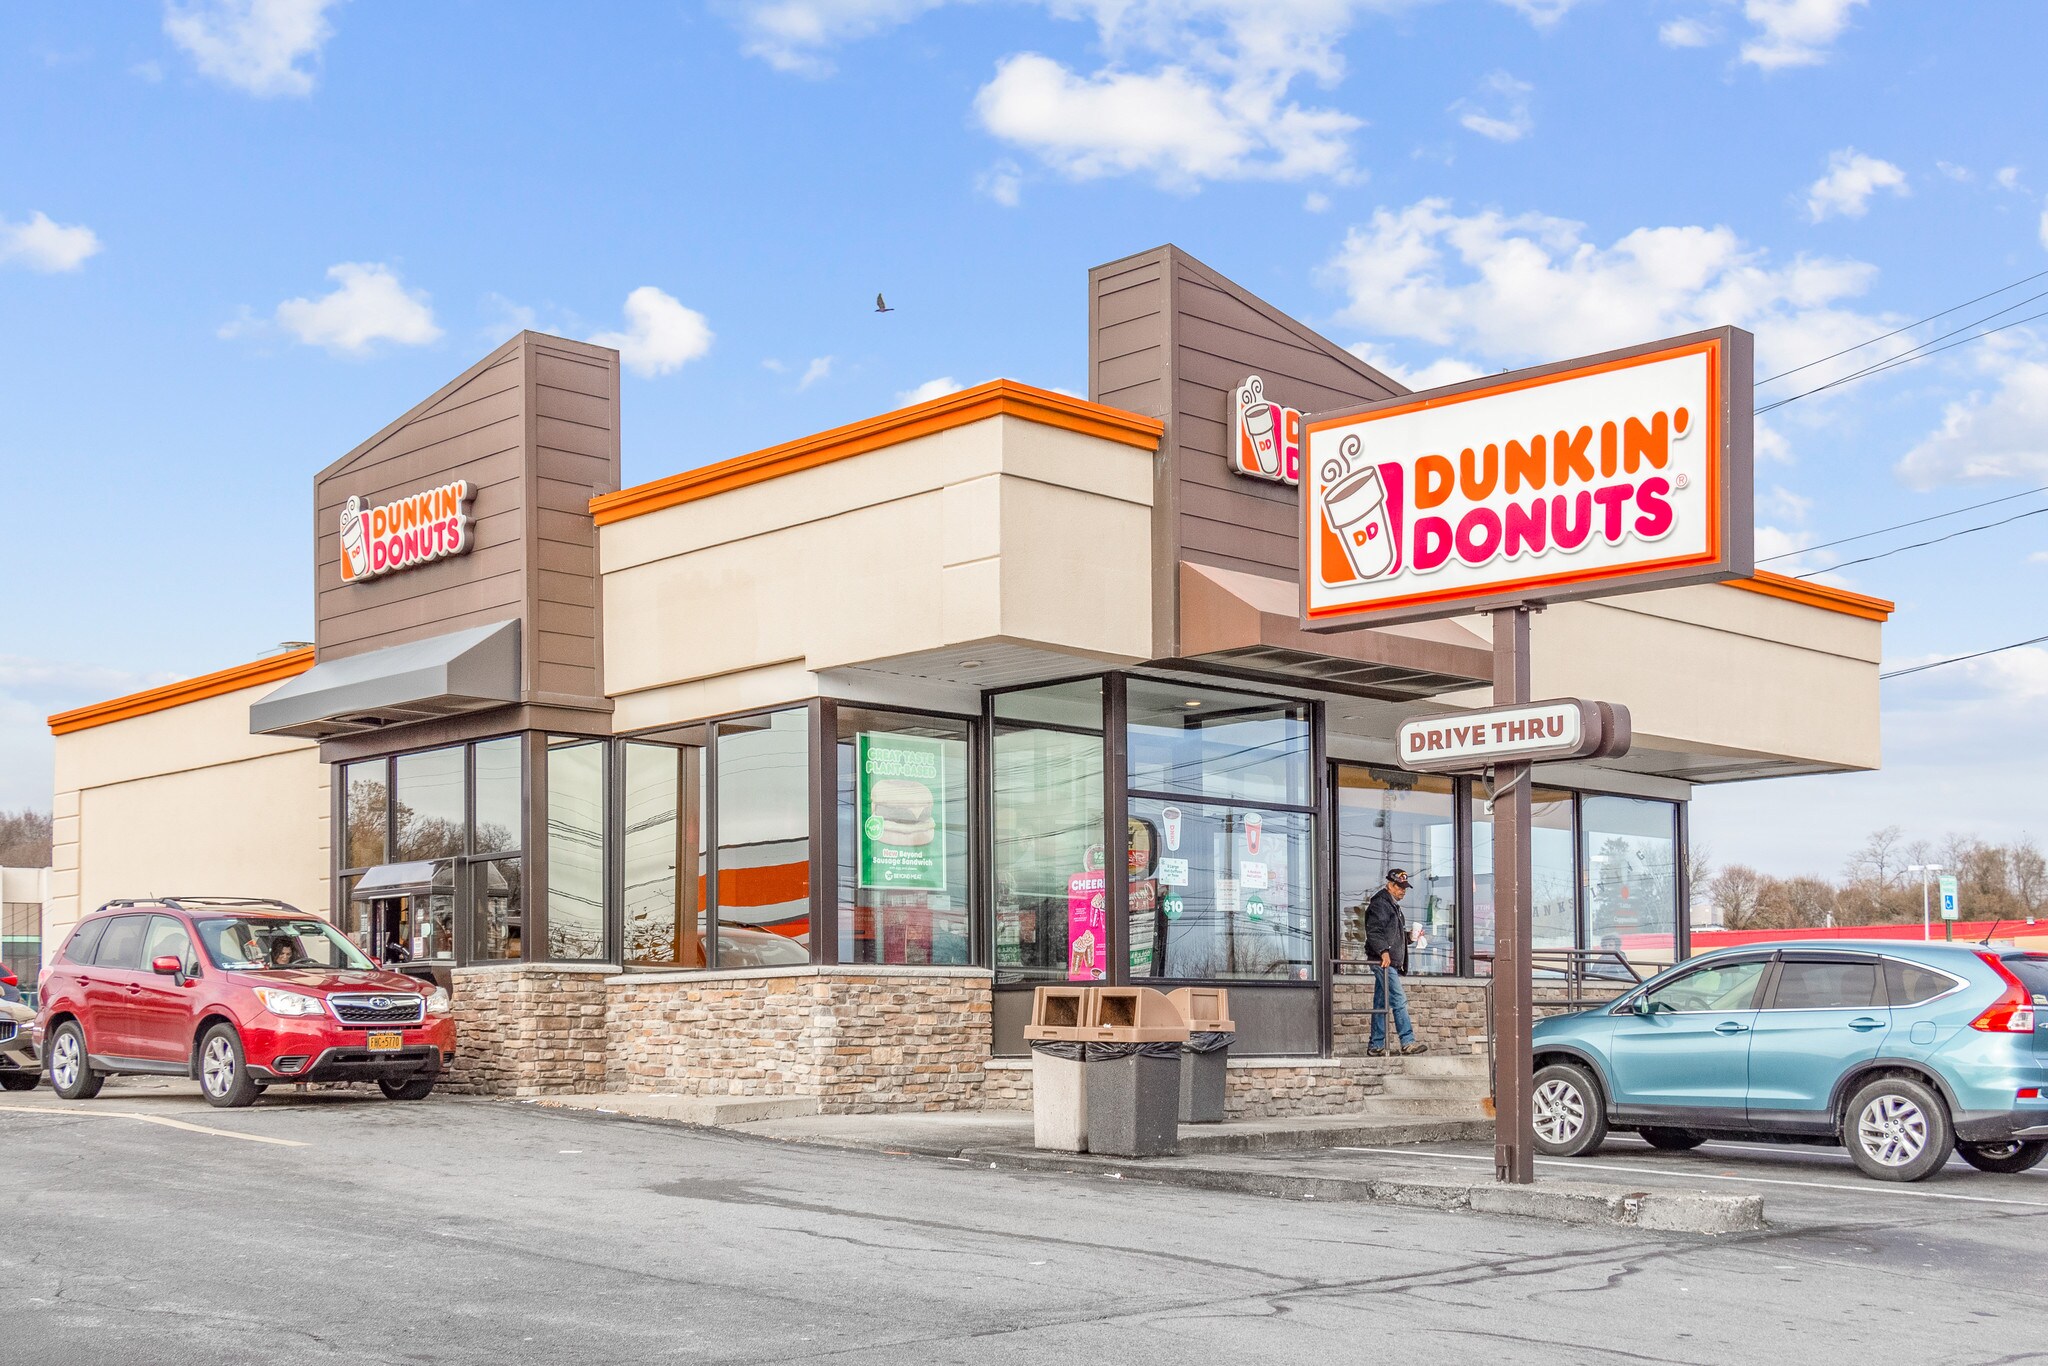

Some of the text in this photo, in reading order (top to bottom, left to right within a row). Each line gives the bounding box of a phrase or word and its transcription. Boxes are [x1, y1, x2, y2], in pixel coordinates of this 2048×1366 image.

[1259, 439, 1272, 451] DD
[1414, 407, 1690, 509] DUNKIN'
[373, 484, 462, 538] DUNKIN'
[1413, 477, 1673, 570] DONUTS
[1353, 522, 1378, 546] DD
[352, 545, 360, 558] DD
[373, 518, 459, 570] DONUTS
[1410, 715, 1564, 752] DRIVE THRU
[868, 748, 934, 765] GREAT TASTE
[883, 848, 898, 857] New
[873, 857, 933, 866] Sausage Sandwich
[1072, 879, 1105, 890] CHEER
[1164, 900, 1183, 912] $10
[1247, 903, 1263, 915] $10
[1533, 898, 1574, 917] ANKS
